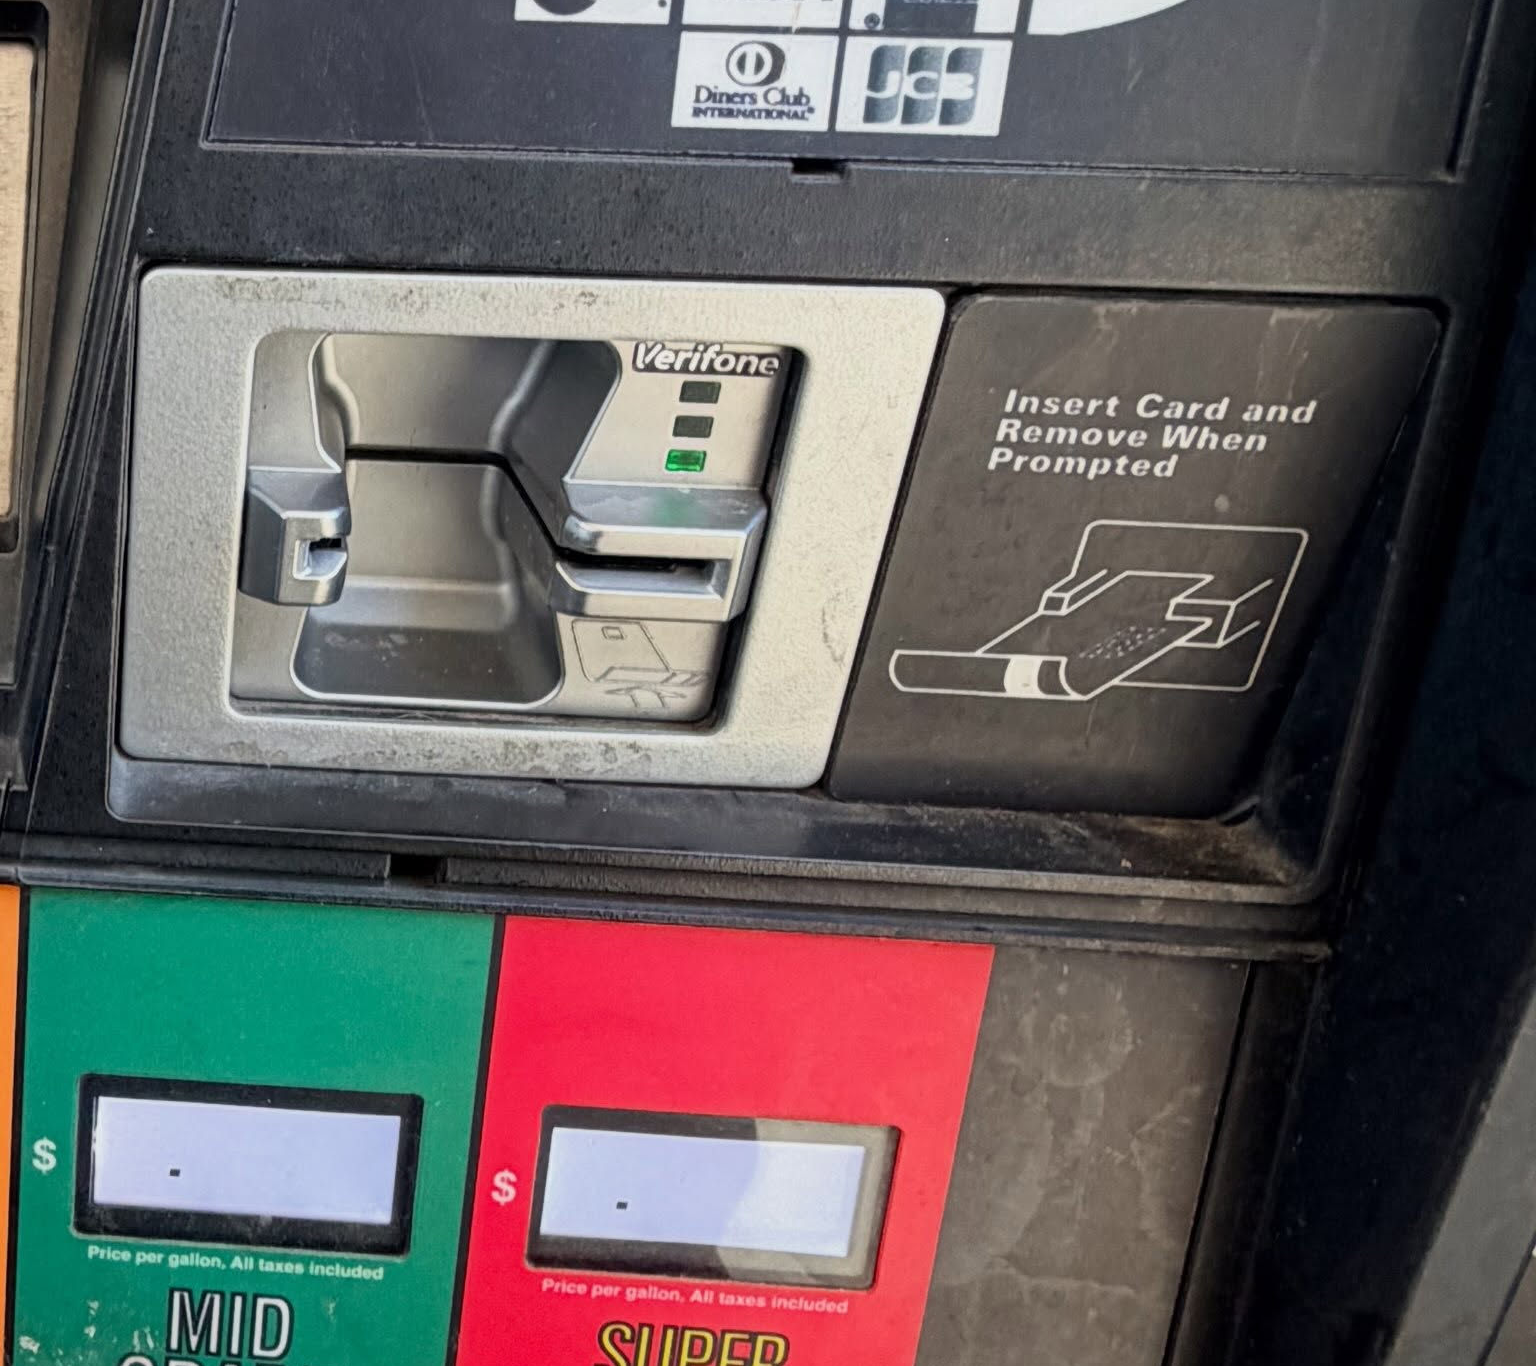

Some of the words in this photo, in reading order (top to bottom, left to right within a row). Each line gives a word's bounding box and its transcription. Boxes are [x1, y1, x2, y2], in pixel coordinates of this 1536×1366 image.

[693, 84, 757, 105] Diners
[763, 86, 811, 106] Club
[634, 342, 780, 376] Verifone
[1004, 388, 1121, 418] Insert
[1135, 392, 1231, 422] Card
[1241, 399, 1318, 425] and
[994, 418, 1148, 449] Remove
[1161, 423, 1268, 453] When
[986, 447, 1180, 480] Prompted
[31, 1136, 58, 1175] $
[490, 1168, 518, 1206] $
[87, 1244, 132, 1262] Price
[135, 1251, 164, 1267] per
[230, 1255, 254, 1271] All
[258, 1257, 305, 1275] taxes
[309, 1261, 384, 1281] included
[541, 1277, 587, 1295] Price
[591, 1284, 621, 1300] per
[689, 1288, 714, 1305] All
[719, 1291, 767, 1308] taxes
[771, 1295, 849, 1314] included
[168, 1287, 295, 1361] MID
